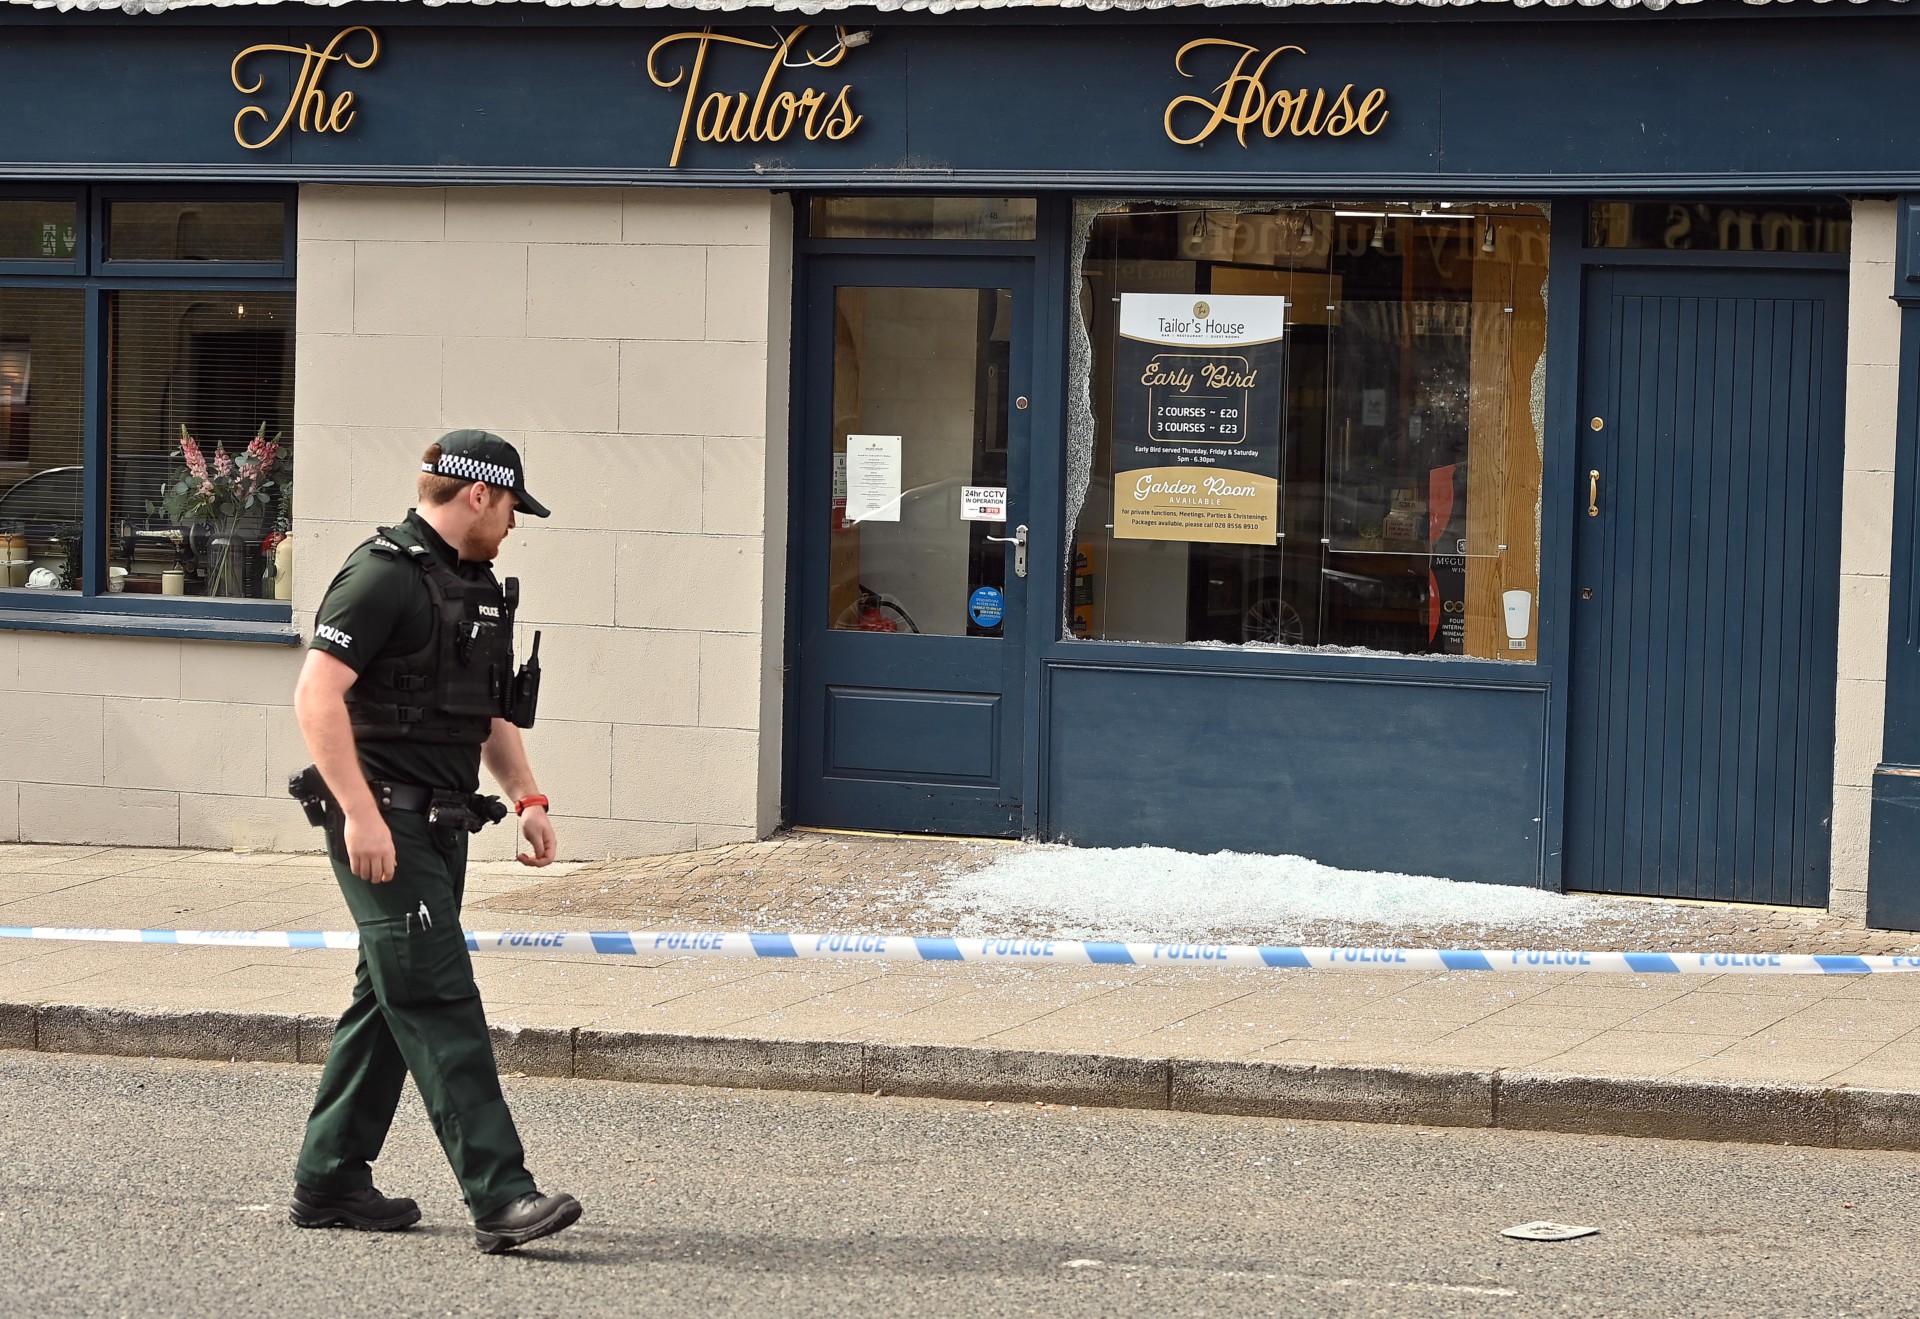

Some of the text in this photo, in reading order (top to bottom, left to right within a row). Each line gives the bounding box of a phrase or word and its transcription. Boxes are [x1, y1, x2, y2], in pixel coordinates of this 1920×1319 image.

[231, 25, 1389, 167] The Tailors House
[1158, 318, 1245, 334] Tailor's House
[1141, 362, 1257, 393] Early Bird
[1157, 407, 1163, 416] 2
[1165, 407, 1206, 417] COURSES
[1220, 409, 1238, 418] £20
[1157, 422, 1163, 431] 3
[1165, 422, 1206, 432] COURSES
[1219, 424, 1237, 434] £23
[1135, 446, 1149, 454] Early
[1209, 448, 1226, 456] Friday
[1233, 449, 1259, 457] Saturday
[983, 490, 1005, 498] CCTV
[1133, 475, 1256, 501] Garden Room
[1169, 497, 1221, 505] AVAILABLE
[1131, 518, 1157, 526] Packages
[1206, 511, 1227, 519] Parties
[479, 605, 500, 617] POLICE
[315, 623, 353, 649] POLICE
[497, 930, 567, 948] POLICE
[654, 932, 727, 951] POLICE
[815, 934, 887, 953] POLICE
[982, 937, 1055, 957] POLICE
[1153, 942, 1229, 961] POLICE
[1329, 946, 1408, 963] POLICE
